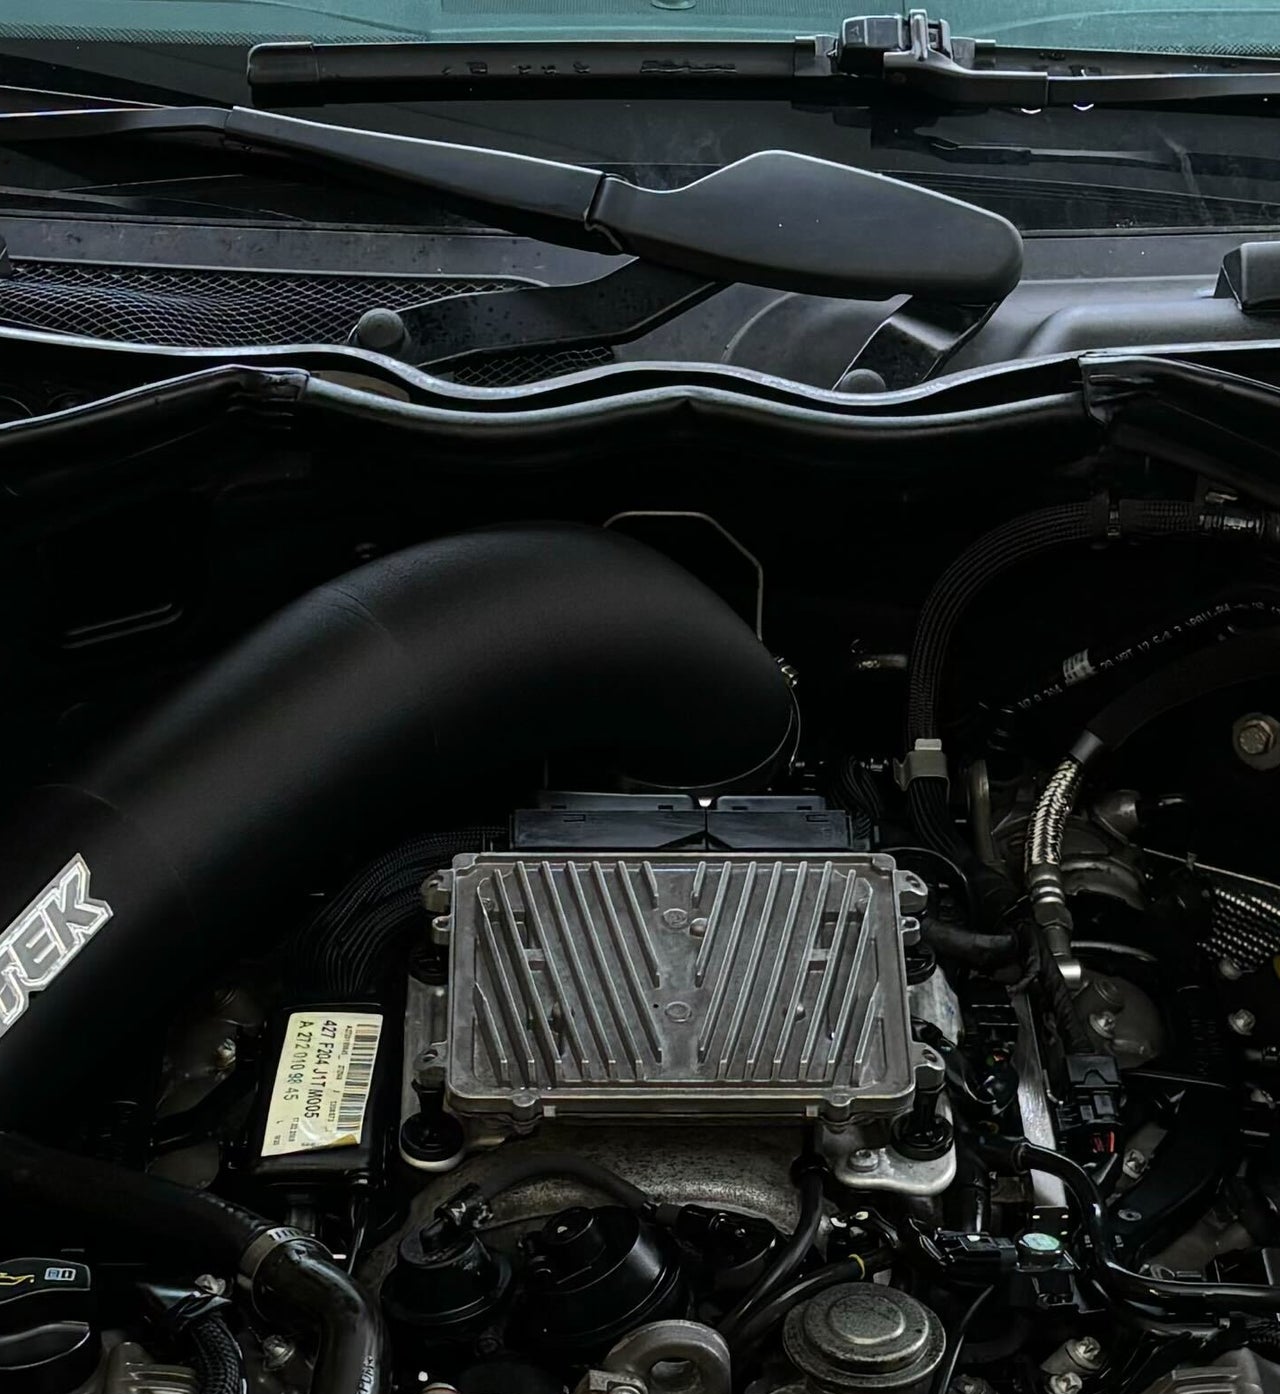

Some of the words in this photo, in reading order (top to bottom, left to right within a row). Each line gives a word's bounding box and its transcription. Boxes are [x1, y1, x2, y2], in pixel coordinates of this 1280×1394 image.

[299, 1020, 314, 1029] A
[320, 1019, 338, 1039] 427
[295, 1032, 313, 1049] 272
[290, 1052, 308, 1071] 010
[316, 1042, 335, 1065] F204
[283, 1087, 299, 1101] 45
[304, 1089, 324, 1119] M005
